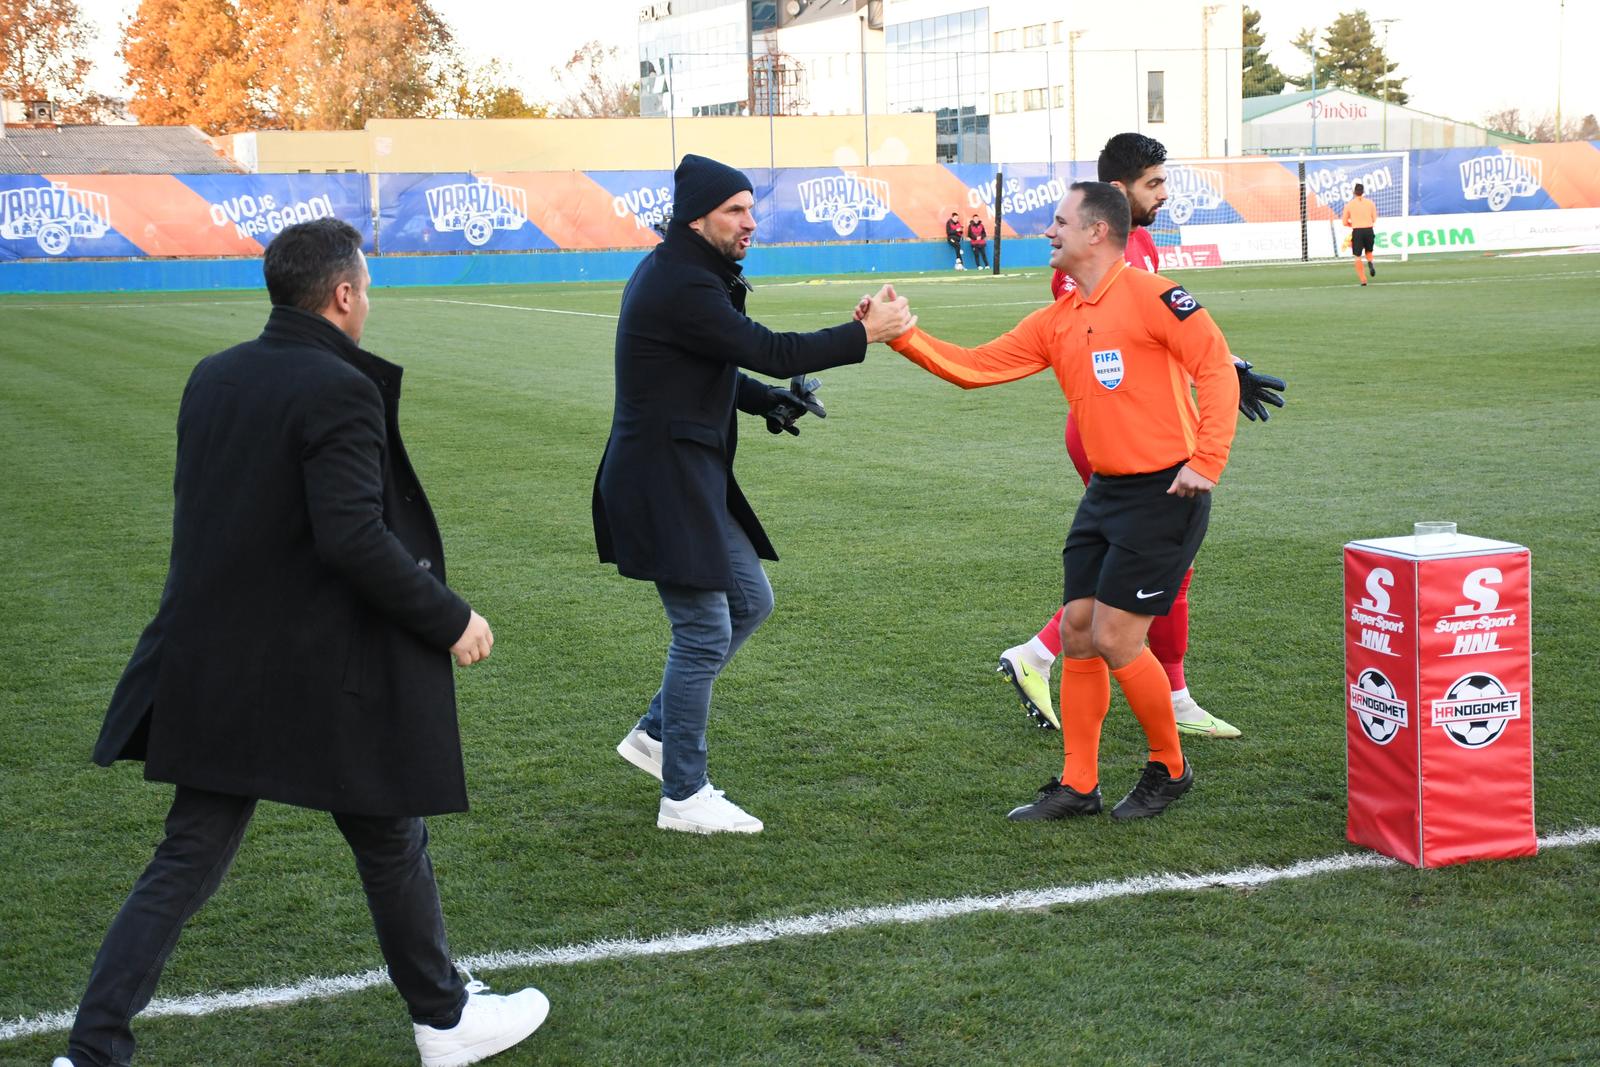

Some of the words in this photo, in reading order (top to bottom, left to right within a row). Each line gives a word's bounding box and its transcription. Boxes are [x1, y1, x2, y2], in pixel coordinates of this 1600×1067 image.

[209, 194, 258, 227] OVO
[265, 193, 335, 234] GRAD!
[612, 187, 655, 217] OVO
[1094, 352, 1119, 363] FIFA
[1351, 608, 1405, 634] SuperSport
[1434, 614, 1517, 634] SuperSport
[1361, 628, 1392, 654] HNL
[1452, 632, 1501, 656] HNL
[1352, 691, 1406, 719] HRNOGOMET
[1435, 700, 1518, 719] HRNOGOMET
